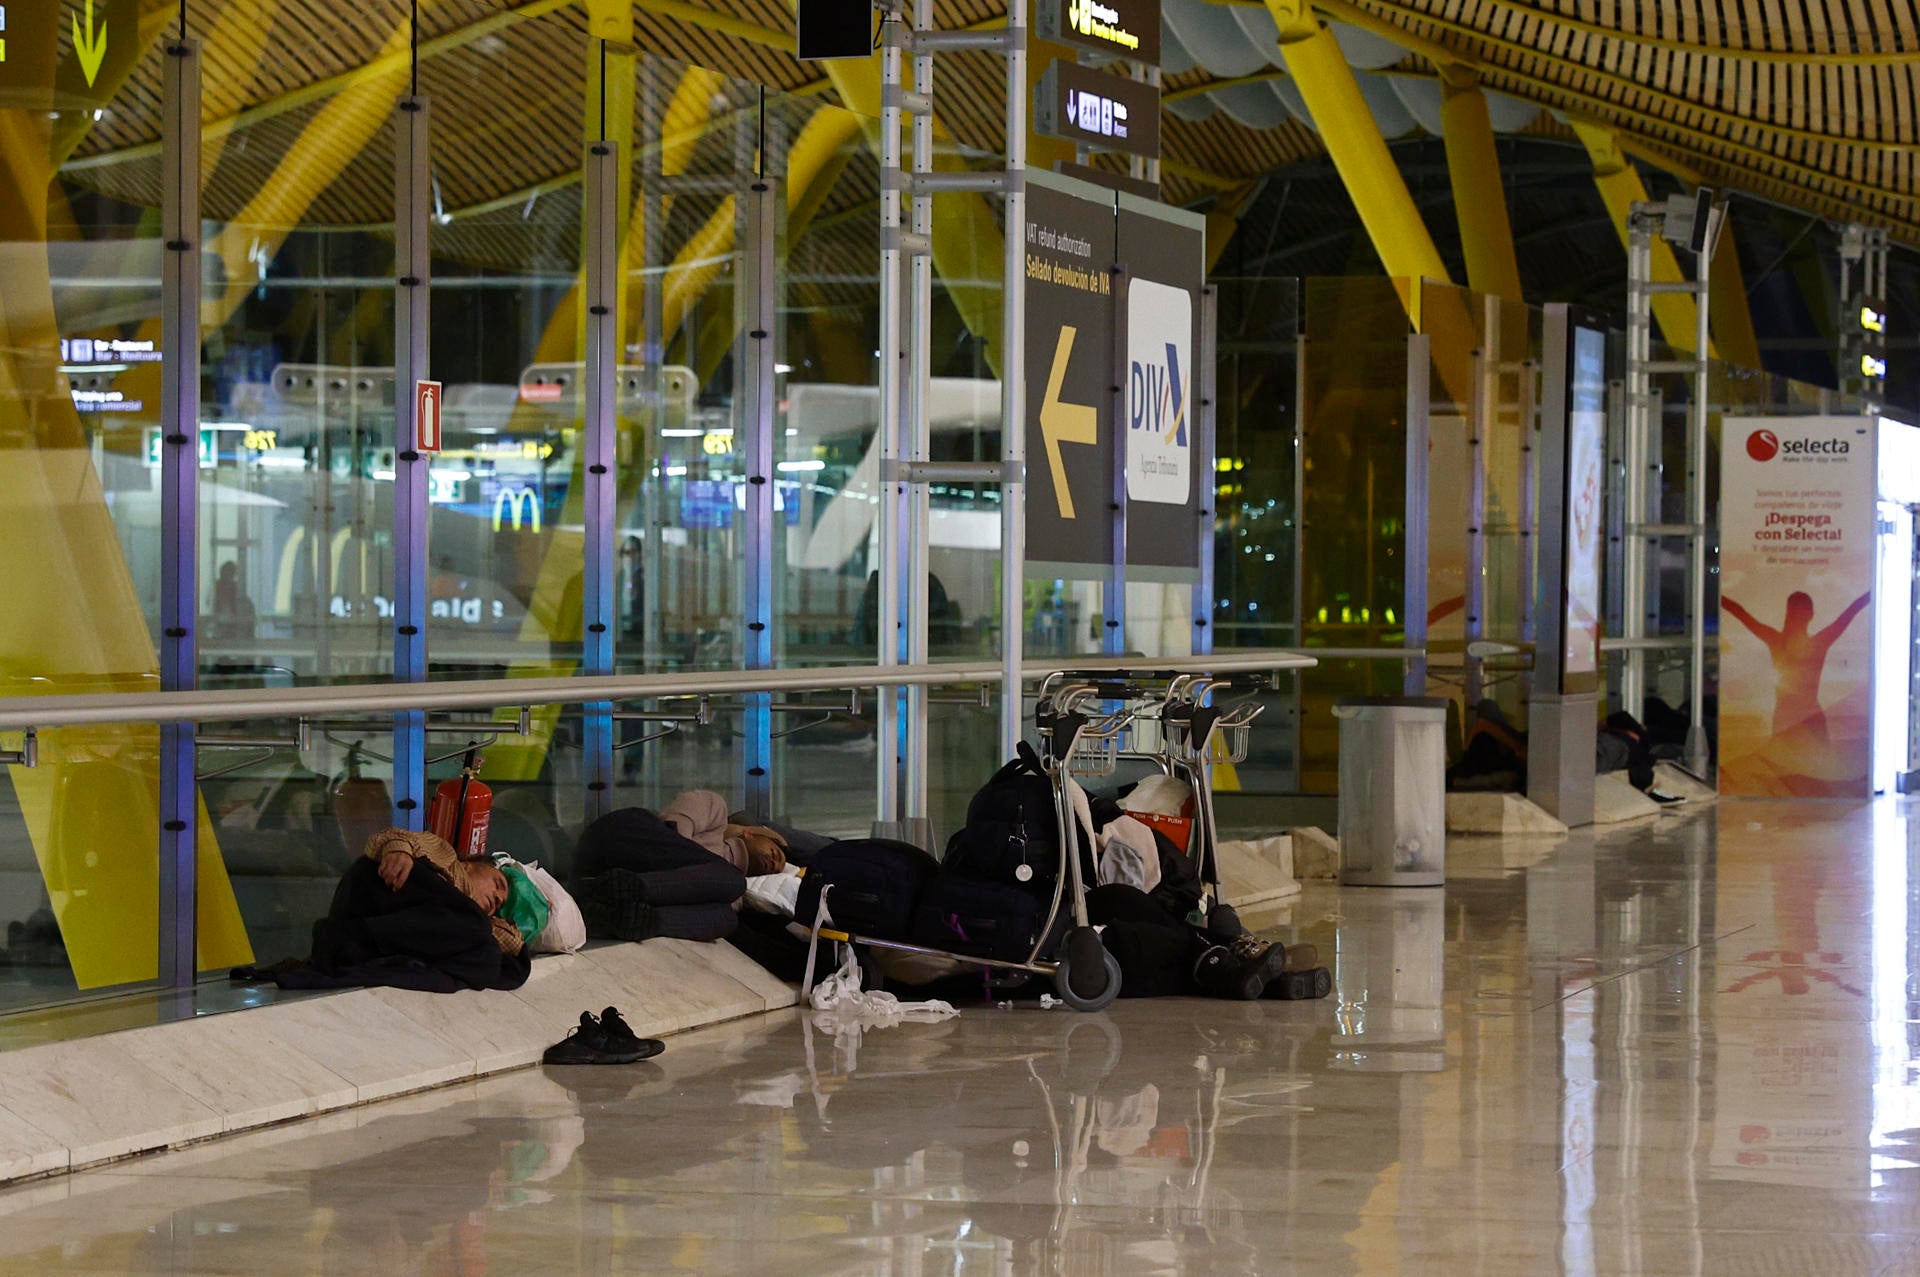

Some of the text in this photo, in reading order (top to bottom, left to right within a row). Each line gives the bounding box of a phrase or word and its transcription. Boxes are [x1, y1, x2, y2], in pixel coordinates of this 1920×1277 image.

[1027, 222, 1091, 257] VAT refund authorization
[1026, 253, 1111, 296] Sellado devolución de IVA
[1782, 438, 1849, 454] selecta
[1765, 512, 1831, 528] ¡Despega
[1755, 528, 1842, 540] con Selecta!
